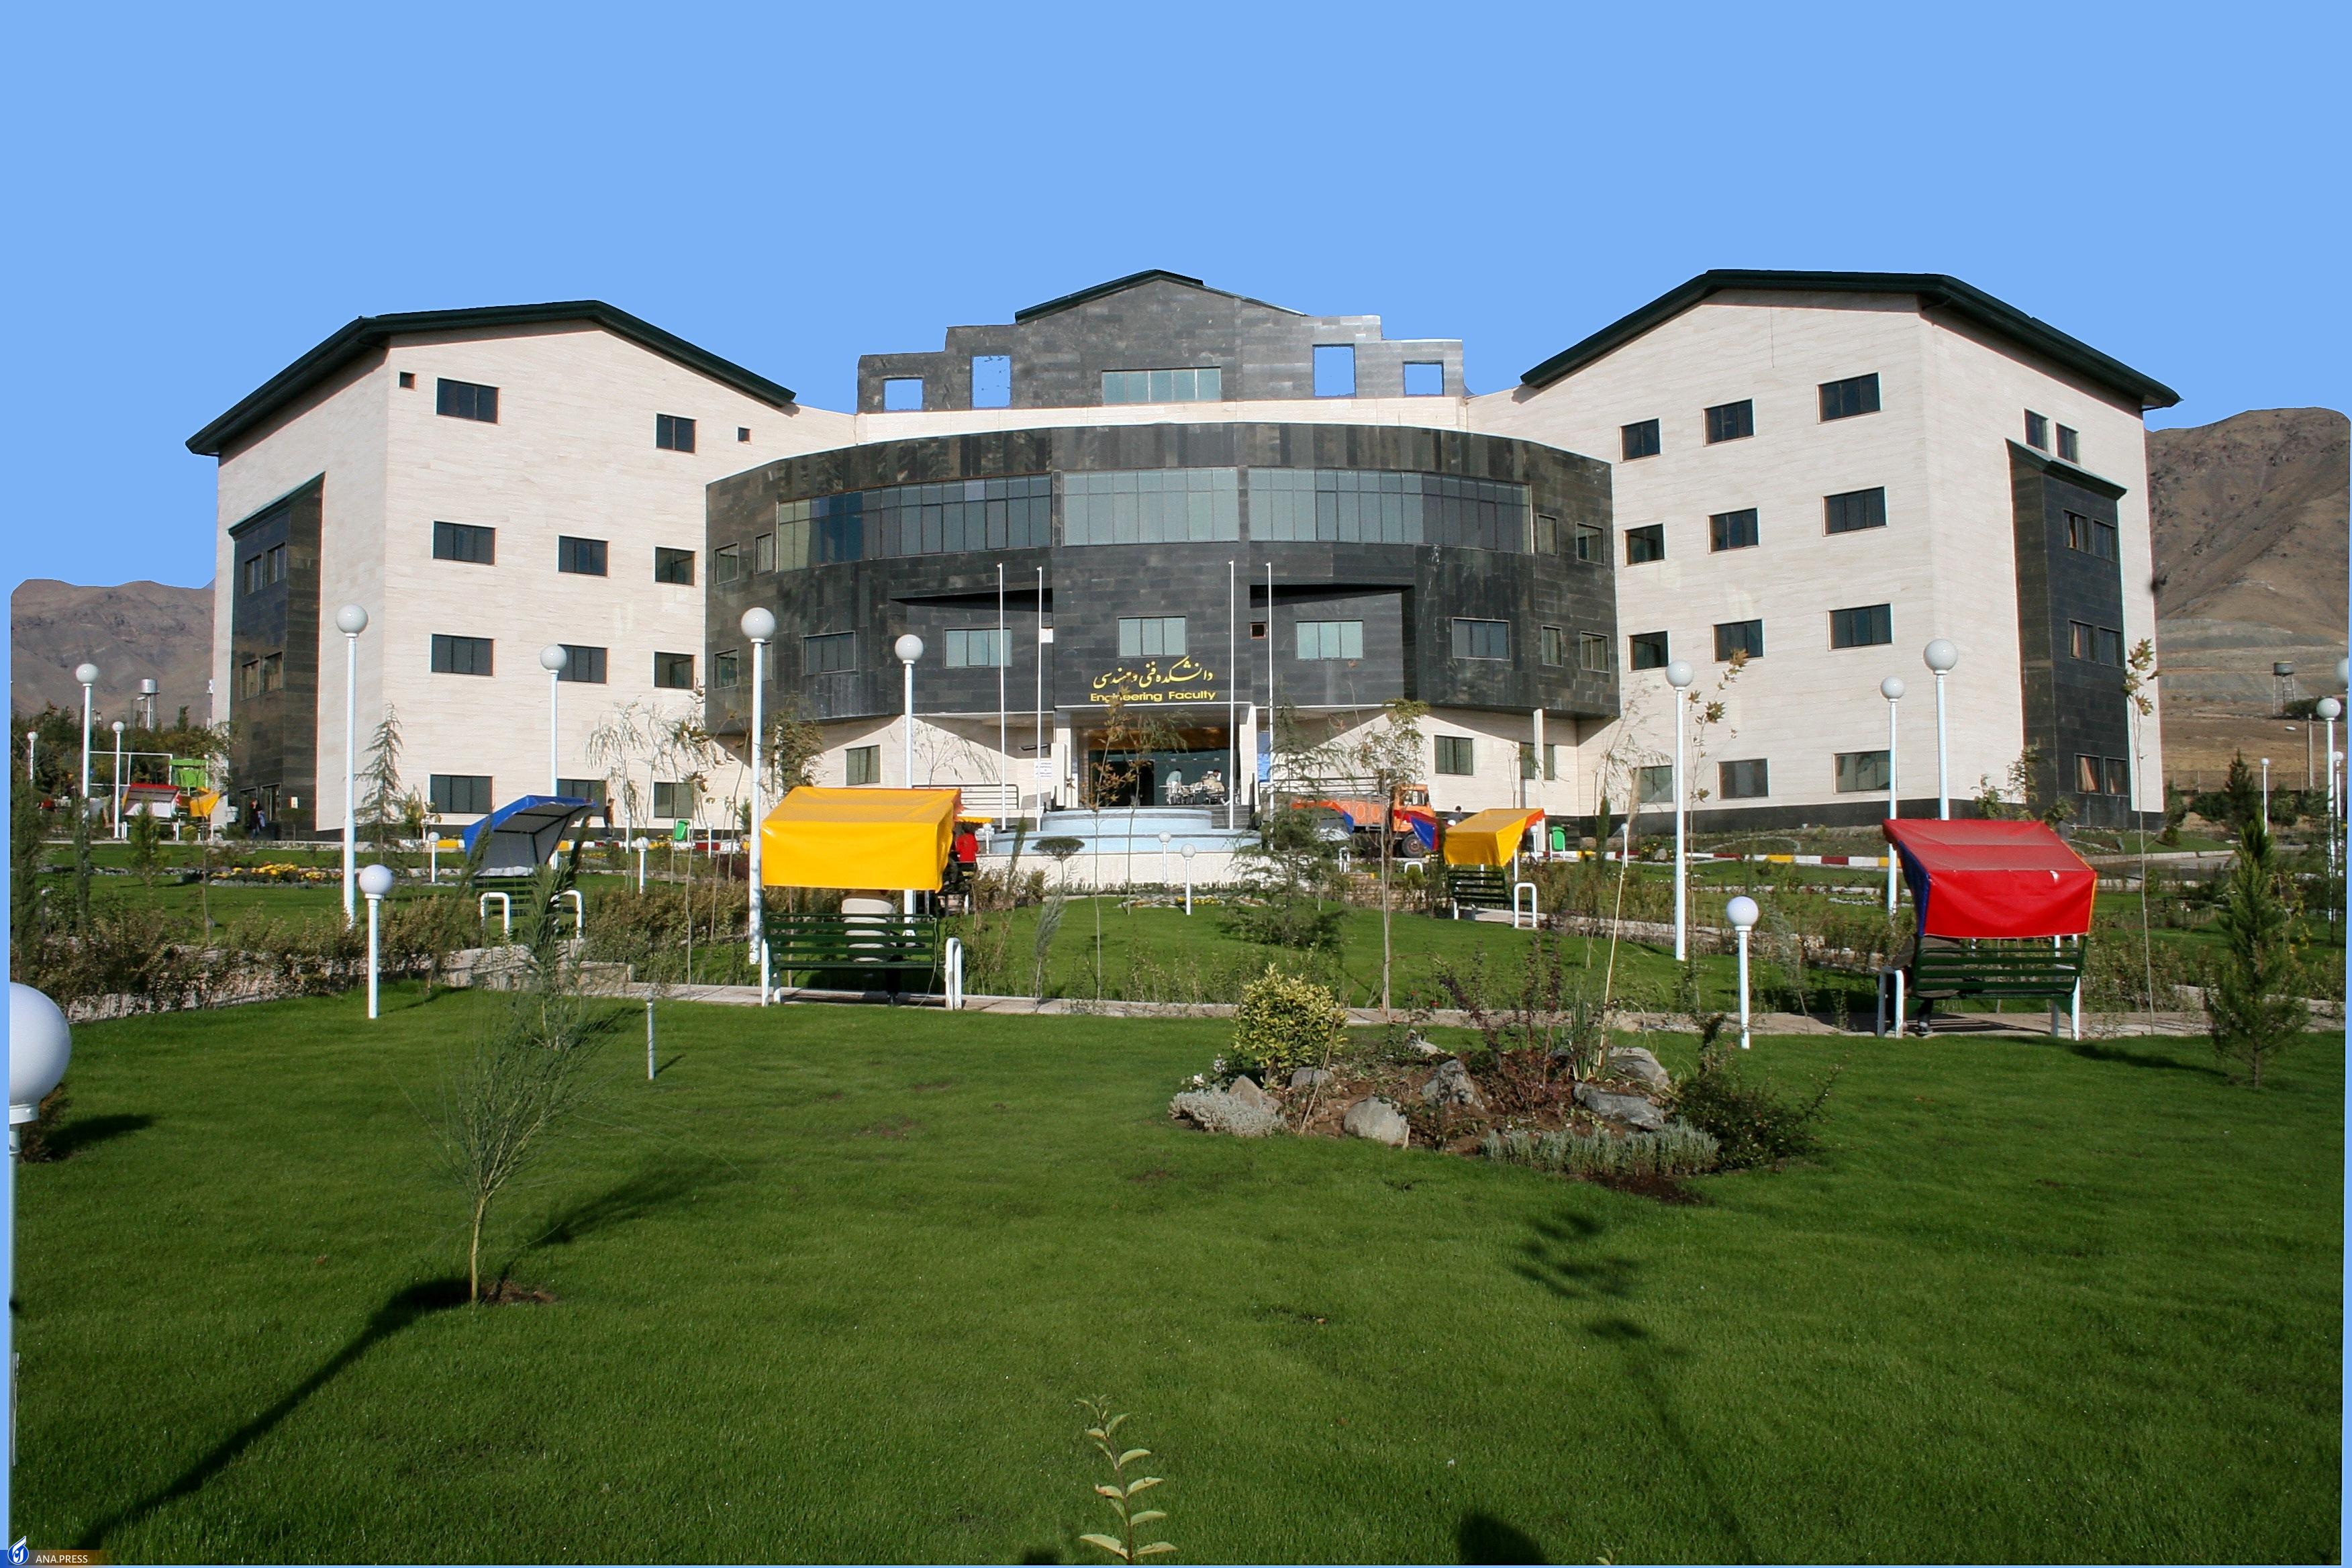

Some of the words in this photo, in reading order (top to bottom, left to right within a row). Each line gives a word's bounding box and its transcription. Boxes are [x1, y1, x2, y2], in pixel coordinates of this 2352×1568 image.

[1138, 660, 1157, 689] فنی
[1156, 655, 1214, 684] دانشکده
[1090, 691, 1163, 703] Engineering
[1168, 690, 1216, 701] Faculty
